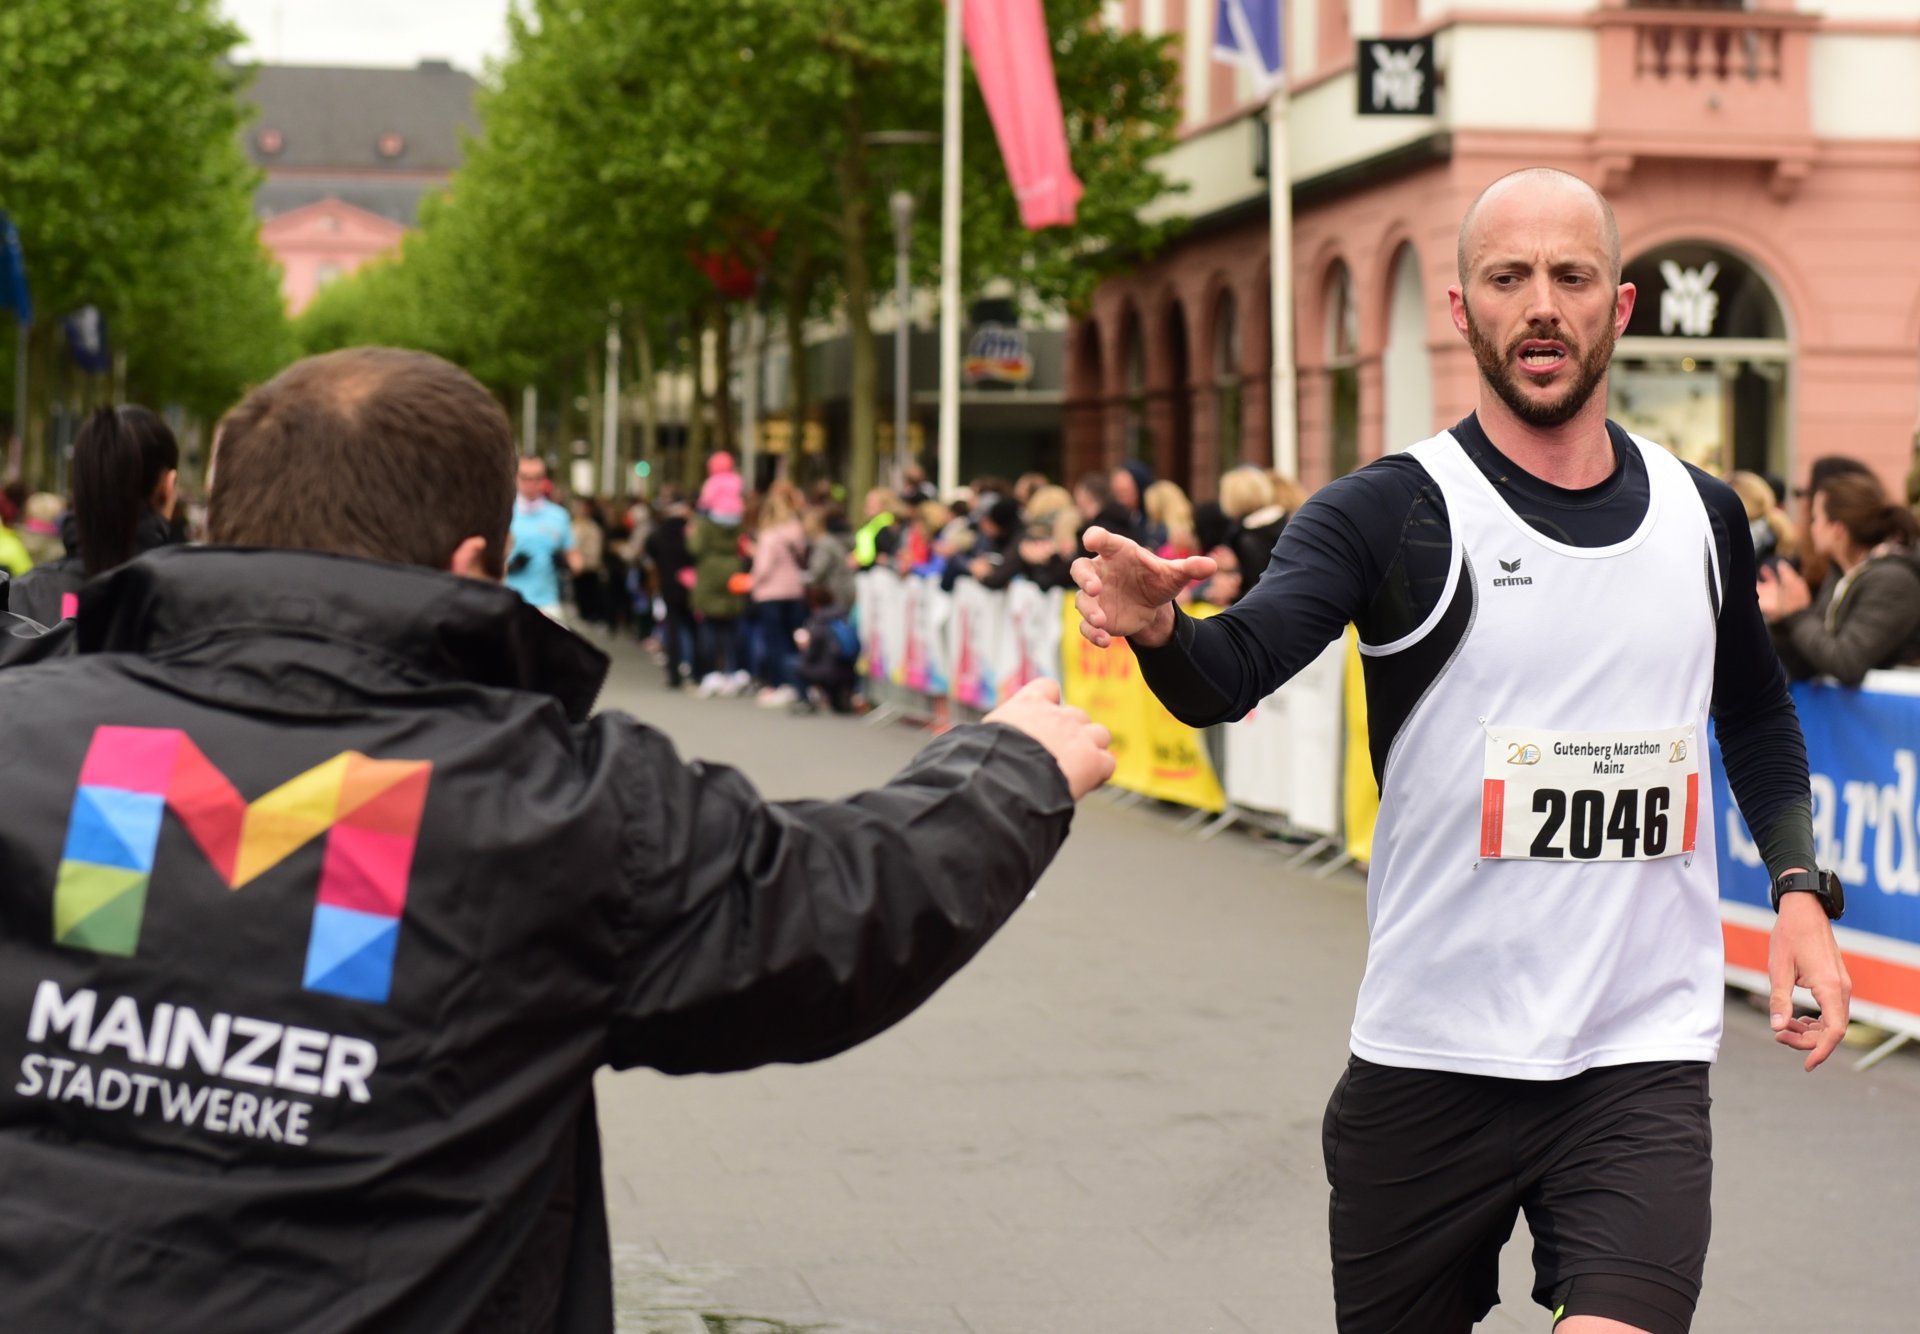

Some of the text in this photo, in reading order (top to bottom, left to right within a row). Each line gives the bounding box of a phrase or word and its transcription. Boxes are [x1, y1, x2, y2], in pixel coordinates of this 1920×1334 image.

[1371, 43, 1425, 110] WMF
[1660, 260, 1719, 336] WMF
[1493, 576, 1533, 587] erima
[1553, 741, 1660, 760] Gutenberg Marathon
[1592, 760, 1625, 774] Mainz
[1529, 786, 1670, 859] 2046
[27, 980, 378, 1103] MAINZER
[16, 1054, 313, 1146] STADTWERKE
